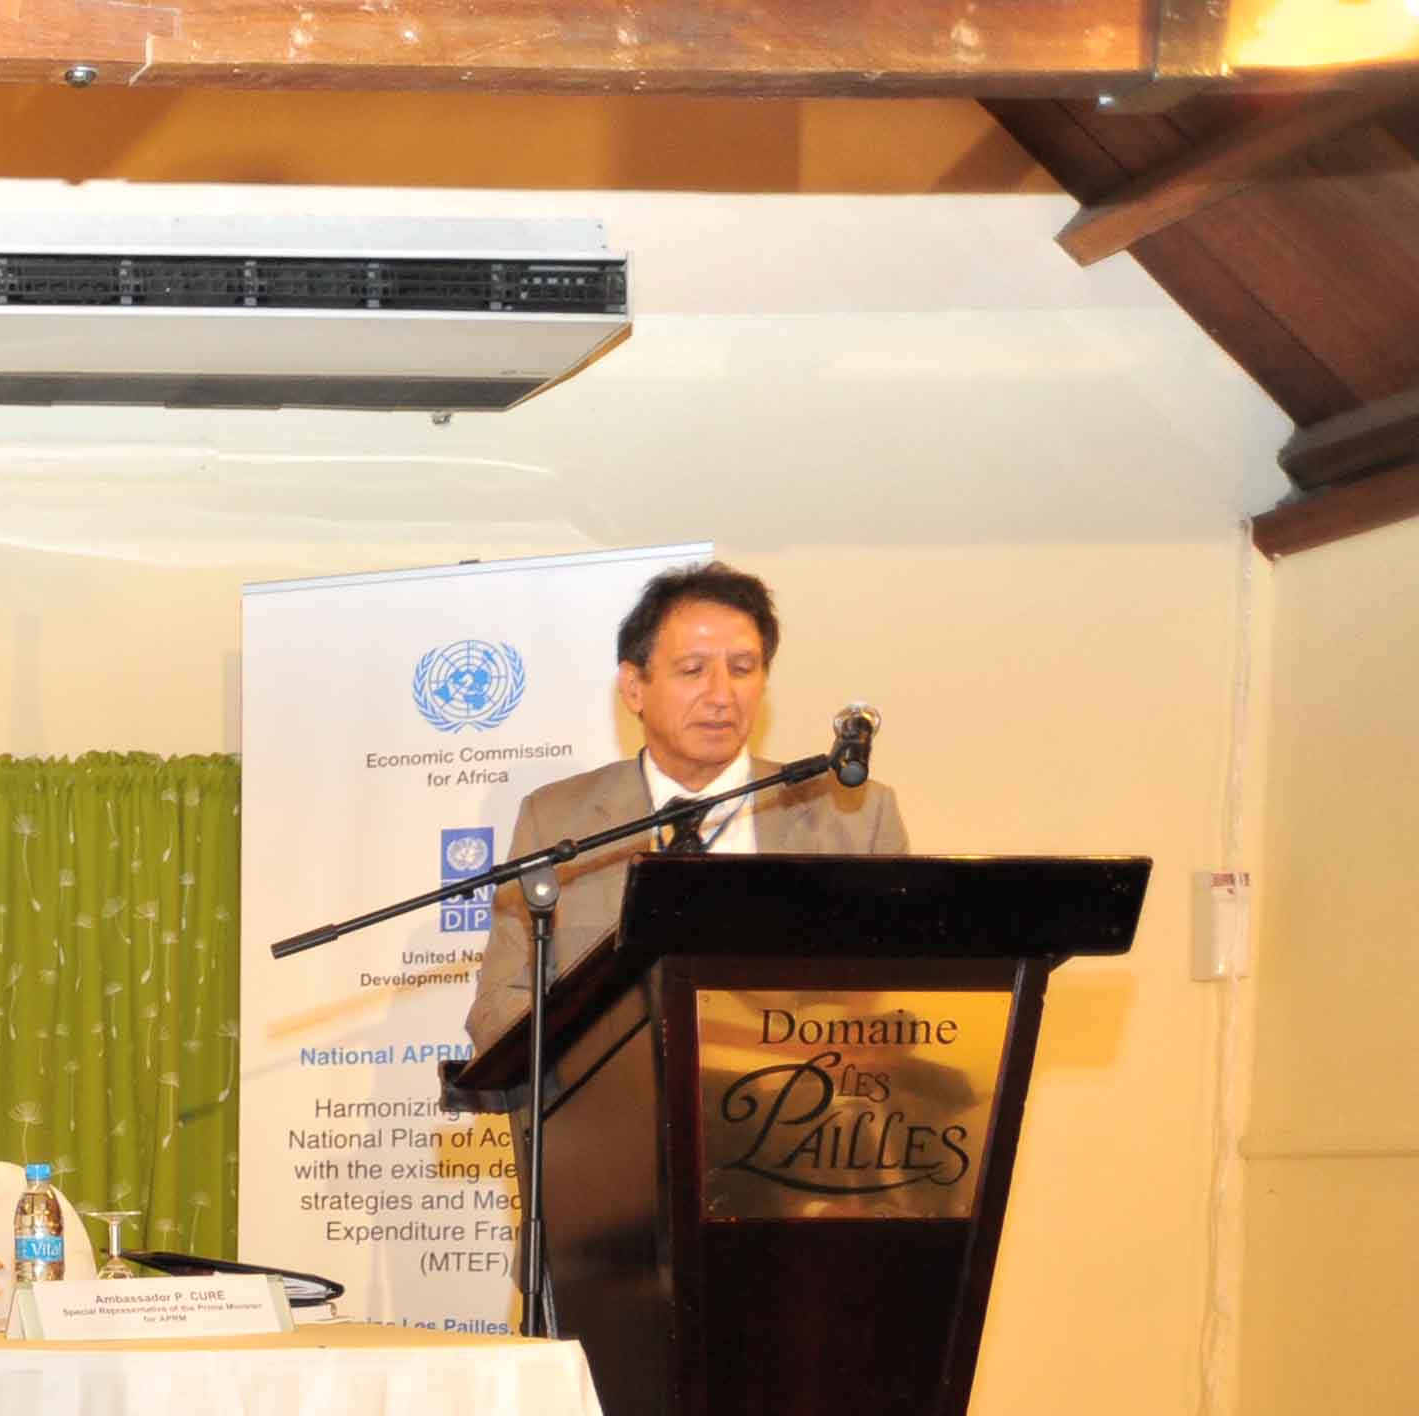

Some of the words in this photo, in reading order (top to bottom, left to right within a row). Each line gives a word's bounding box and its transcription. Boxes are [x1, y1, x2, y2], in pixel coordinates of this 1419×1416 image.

[366, 749, 454, 768] Economic
[460, 743, 573, 763] Commission
[427, 772, 451, 787] for
[456, 769, 508, 786] Africa
[402, 949, 455, 965] United
[360, 970, 470, 987] Development
[758, 1008, 958, 1045] Domaine
[300, 1045, 393, 1067] National
[402, 1044, 473, 1064] APRM
[836, 1064, 891, 1102] LES
[288, 1128, 381, 1149] National
[392, 1127, 442, 1148] Plan
[450, 1127, 472, 1147] of
[295, 1160, 338, 1180] with
[348, 1159, 382, 1179] the
[391, 1159, 479, 1184] existing
[301, 1191, 412, 1215] strategies
[421, 1190, 463, 1210] and
[326, 1220, 464, 1244] Expenditure
[30, 1241, 62, 1258] Vital
[420, 1252, 509, 1276] (MTEF)
[95, 1291, 172, 1305] Ambassador
[190, 1289, 227, 1302] CURE
